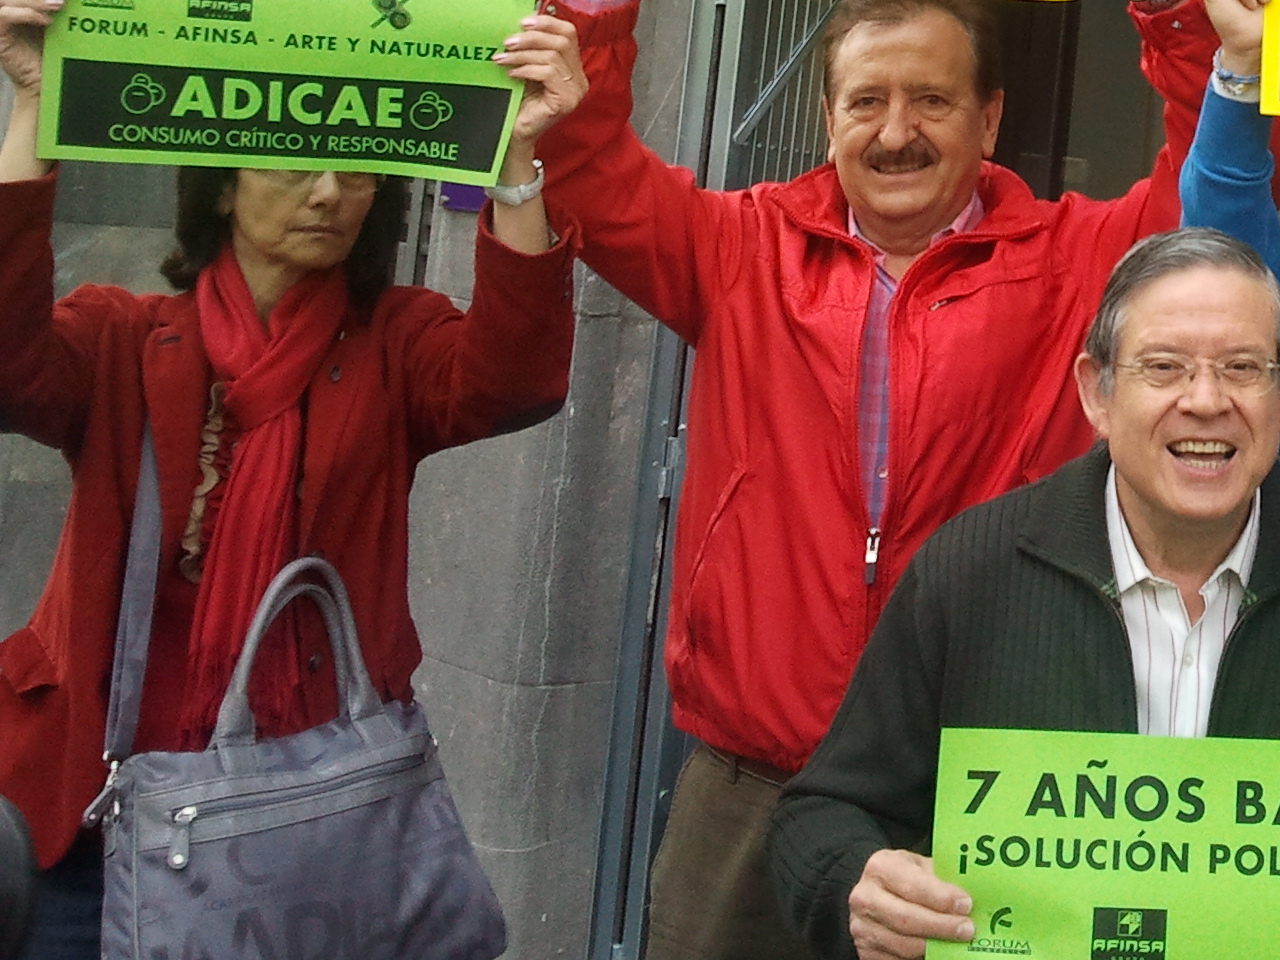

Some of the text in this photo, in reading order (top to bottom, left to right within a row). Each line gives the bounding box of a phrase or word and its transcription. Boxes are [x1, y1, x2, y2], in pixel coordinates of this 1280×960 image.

[68, 16, 148, 38] FORUM
[174, 25, 258, 45] AFINSA
[283, 33, 337, 51] ARTE
[347, 38, 360, 52] Y
[370, 39, 503, 62] NATURALEZ
[170, 75, 405, 128] ADICAE
[108, 123, 460, 161] CONSUMO CRÍTICO Y RESPONSABLE
[964, 770, 1001, 815] 7
[1024, 760, 1206, 823] AÑOS
[959, 830, 1189, 875] ¡SOLUCIÓN
[1093, 938, 1164, 953] AFINSA
